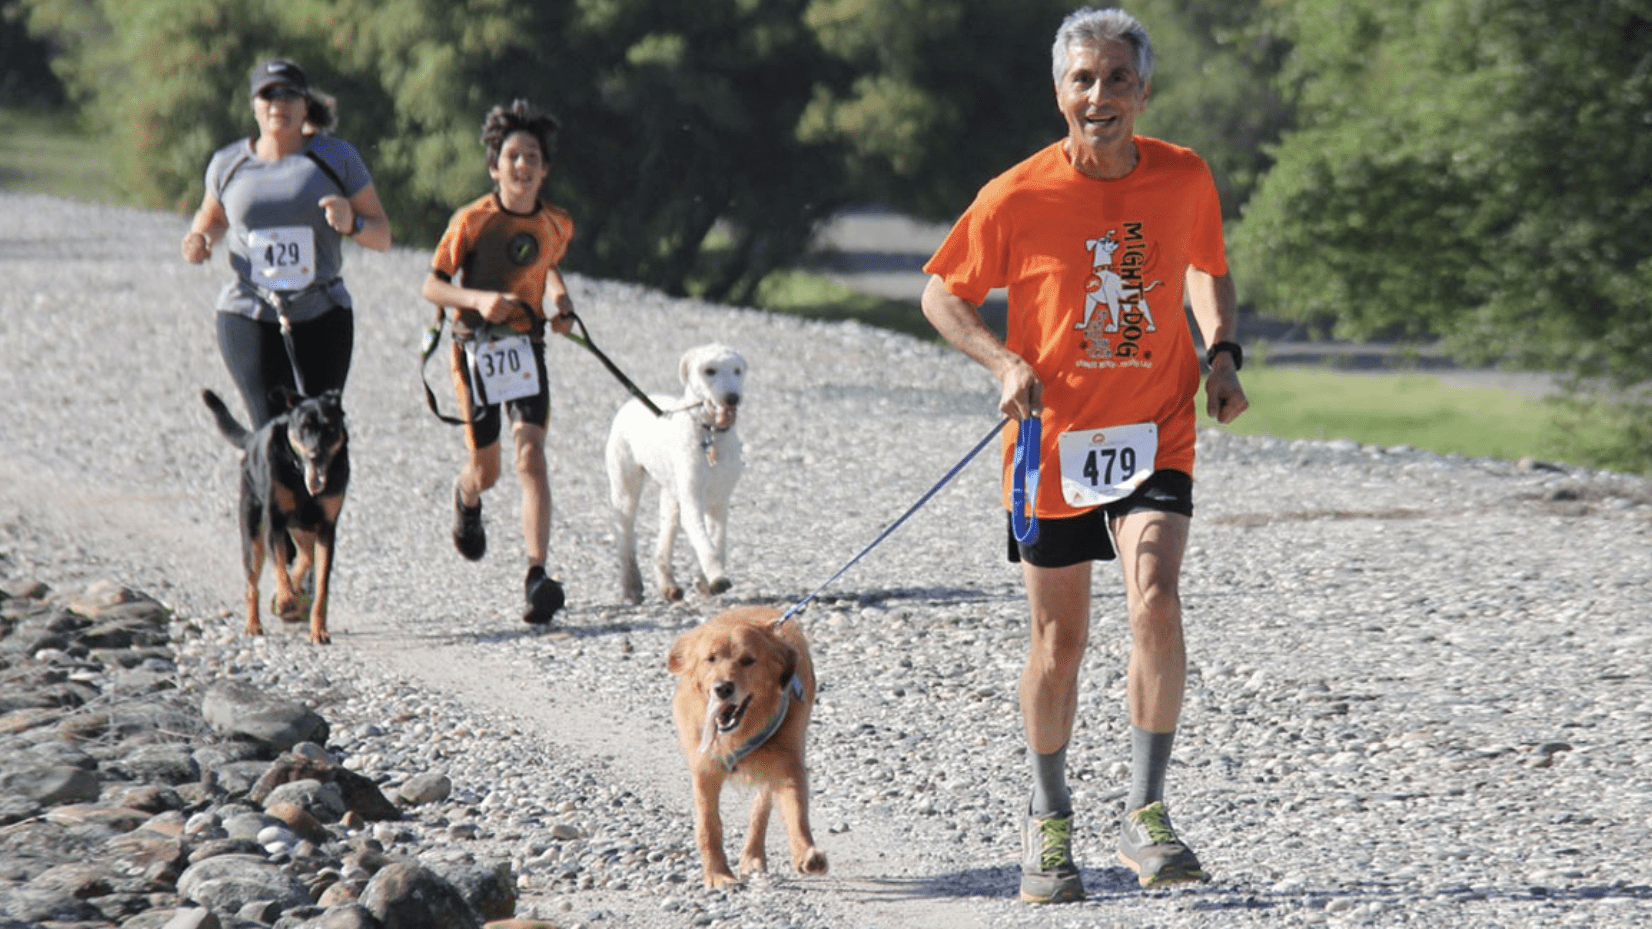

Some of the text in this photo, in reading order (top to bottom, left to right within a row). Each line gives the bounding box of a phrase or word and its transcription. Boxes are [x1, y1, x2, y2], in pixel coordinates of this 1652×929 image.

[264, 241, 300, 267] 429
[1115, 222, 1145, 357] MIGHTY DOG
[481, 348, 521, 378] 370
[1082, 446, 1136, 486] 479
